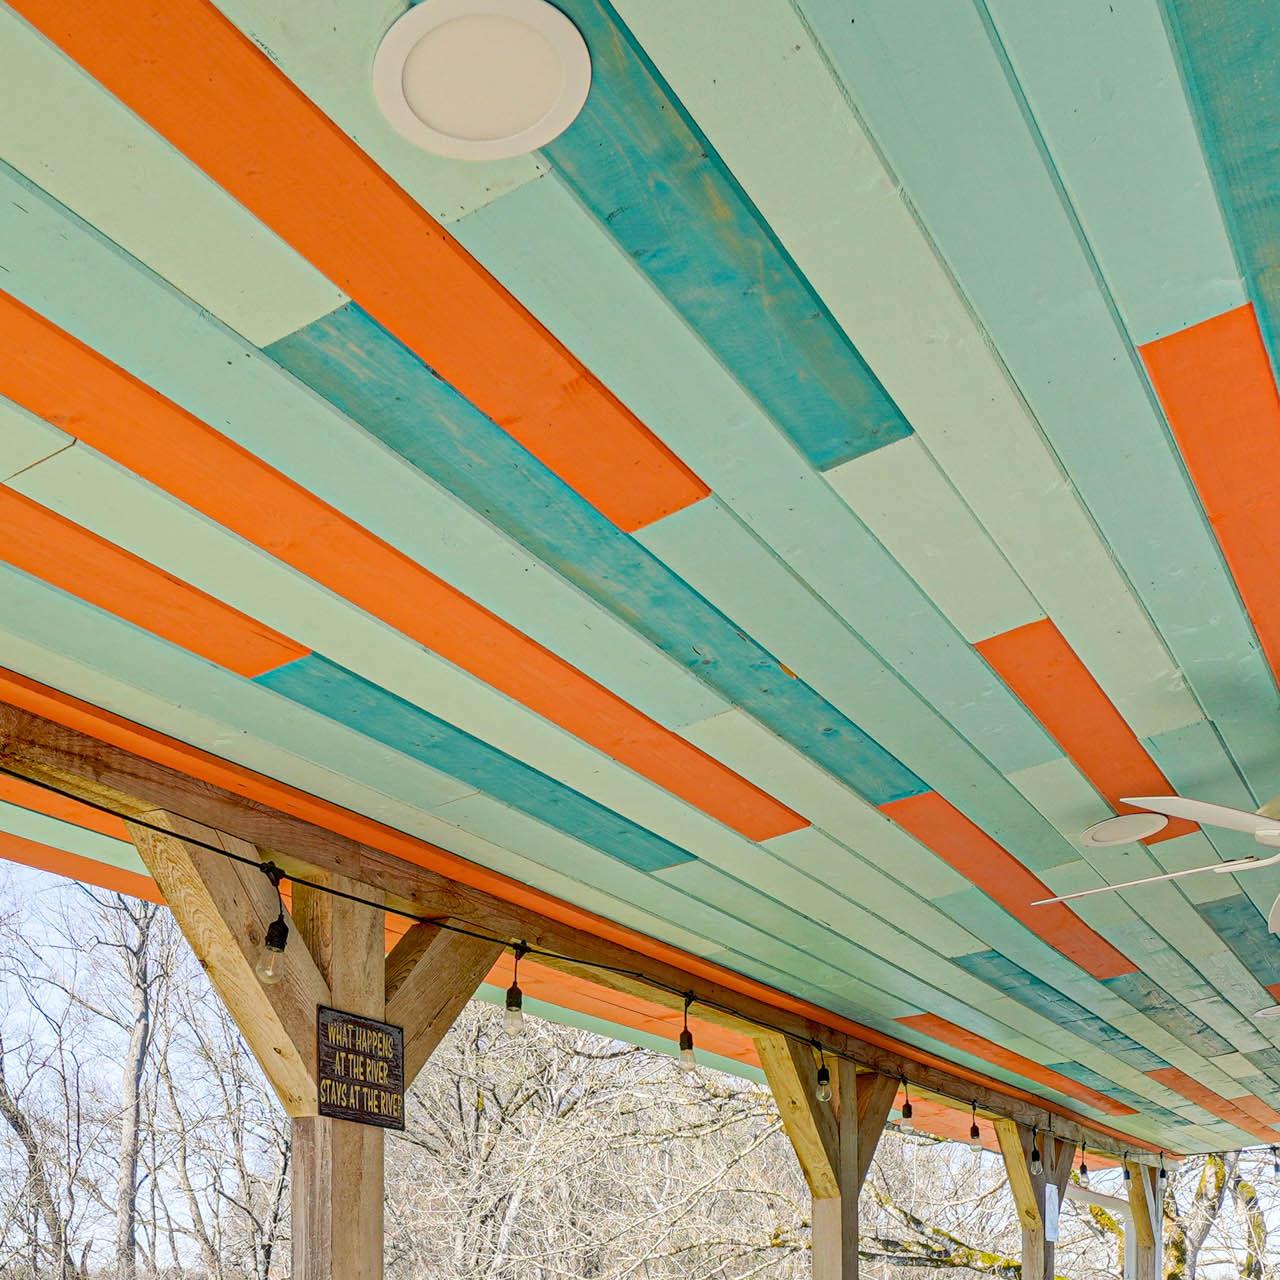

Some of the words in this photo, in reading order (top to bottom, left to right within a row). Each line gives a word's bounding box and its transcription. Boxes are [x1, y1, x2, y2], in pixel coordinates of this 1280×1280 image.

[328, 1023, 352, 1048] WHAT
[356, 1027, 393, 1058] HAPPENS
[335, 1052, 345, 1076] AT
[348, 1054, 363, 1080] THE
[367, 1058, 388, 1084] RIVER
[321, 1080, 347, 1107] STAYS
[349, 1086, 359, 1109] AT
[362, 1087, 378, 1113] THE
[381, 1092, 402, 1117] RIVER
